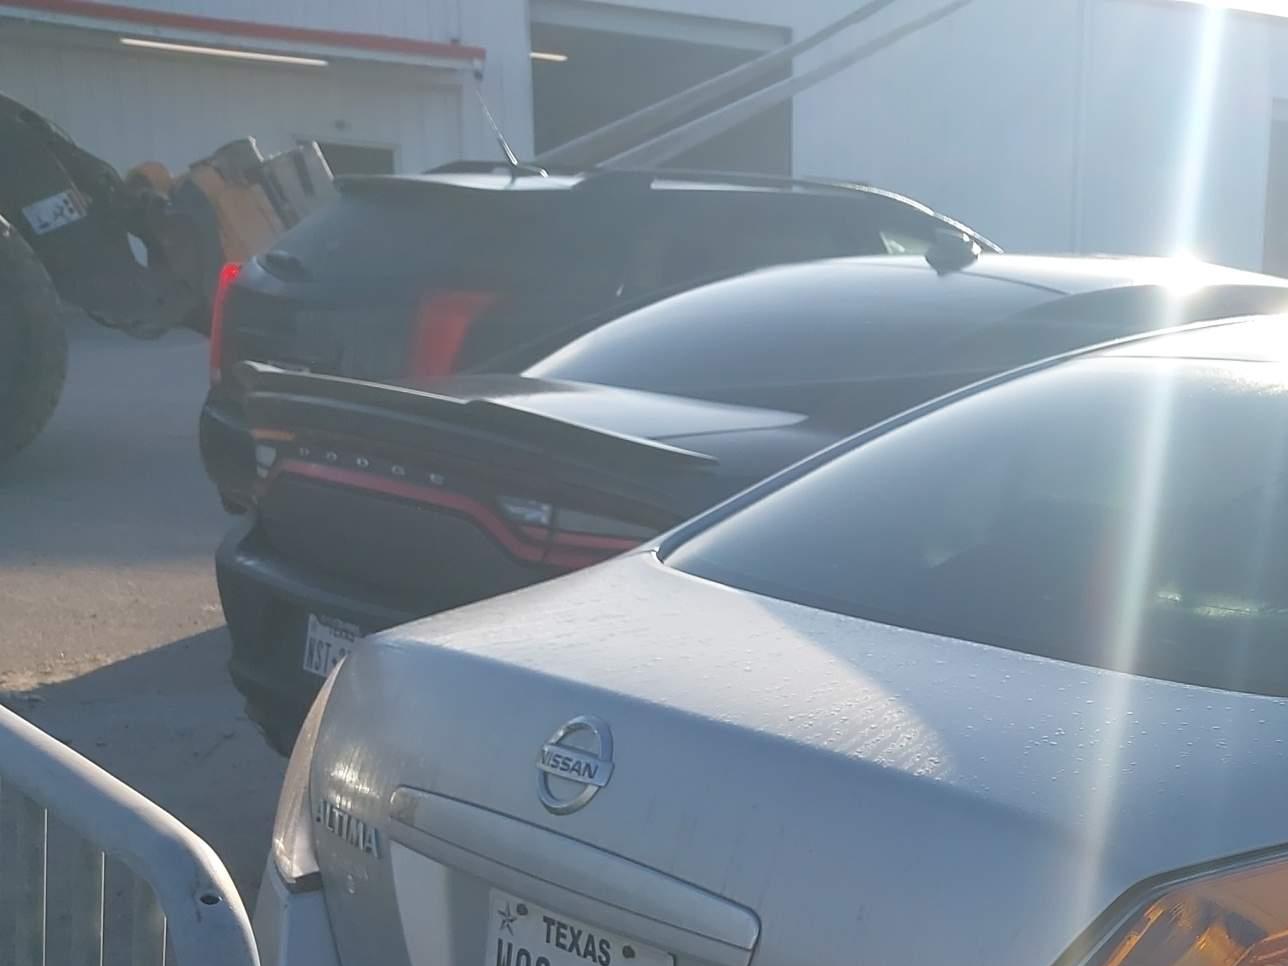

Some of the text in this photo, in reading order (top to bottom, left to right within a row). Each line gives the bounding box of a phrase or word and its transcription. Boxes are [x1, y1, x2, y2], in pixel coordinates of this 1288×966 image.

[299, 447, 445, 486] DODGE
[541, 749, 599, 779] NISSAN
[316, 799, 383, 860] ALTIMA
[542, 915, 611, 966] TEXAS
